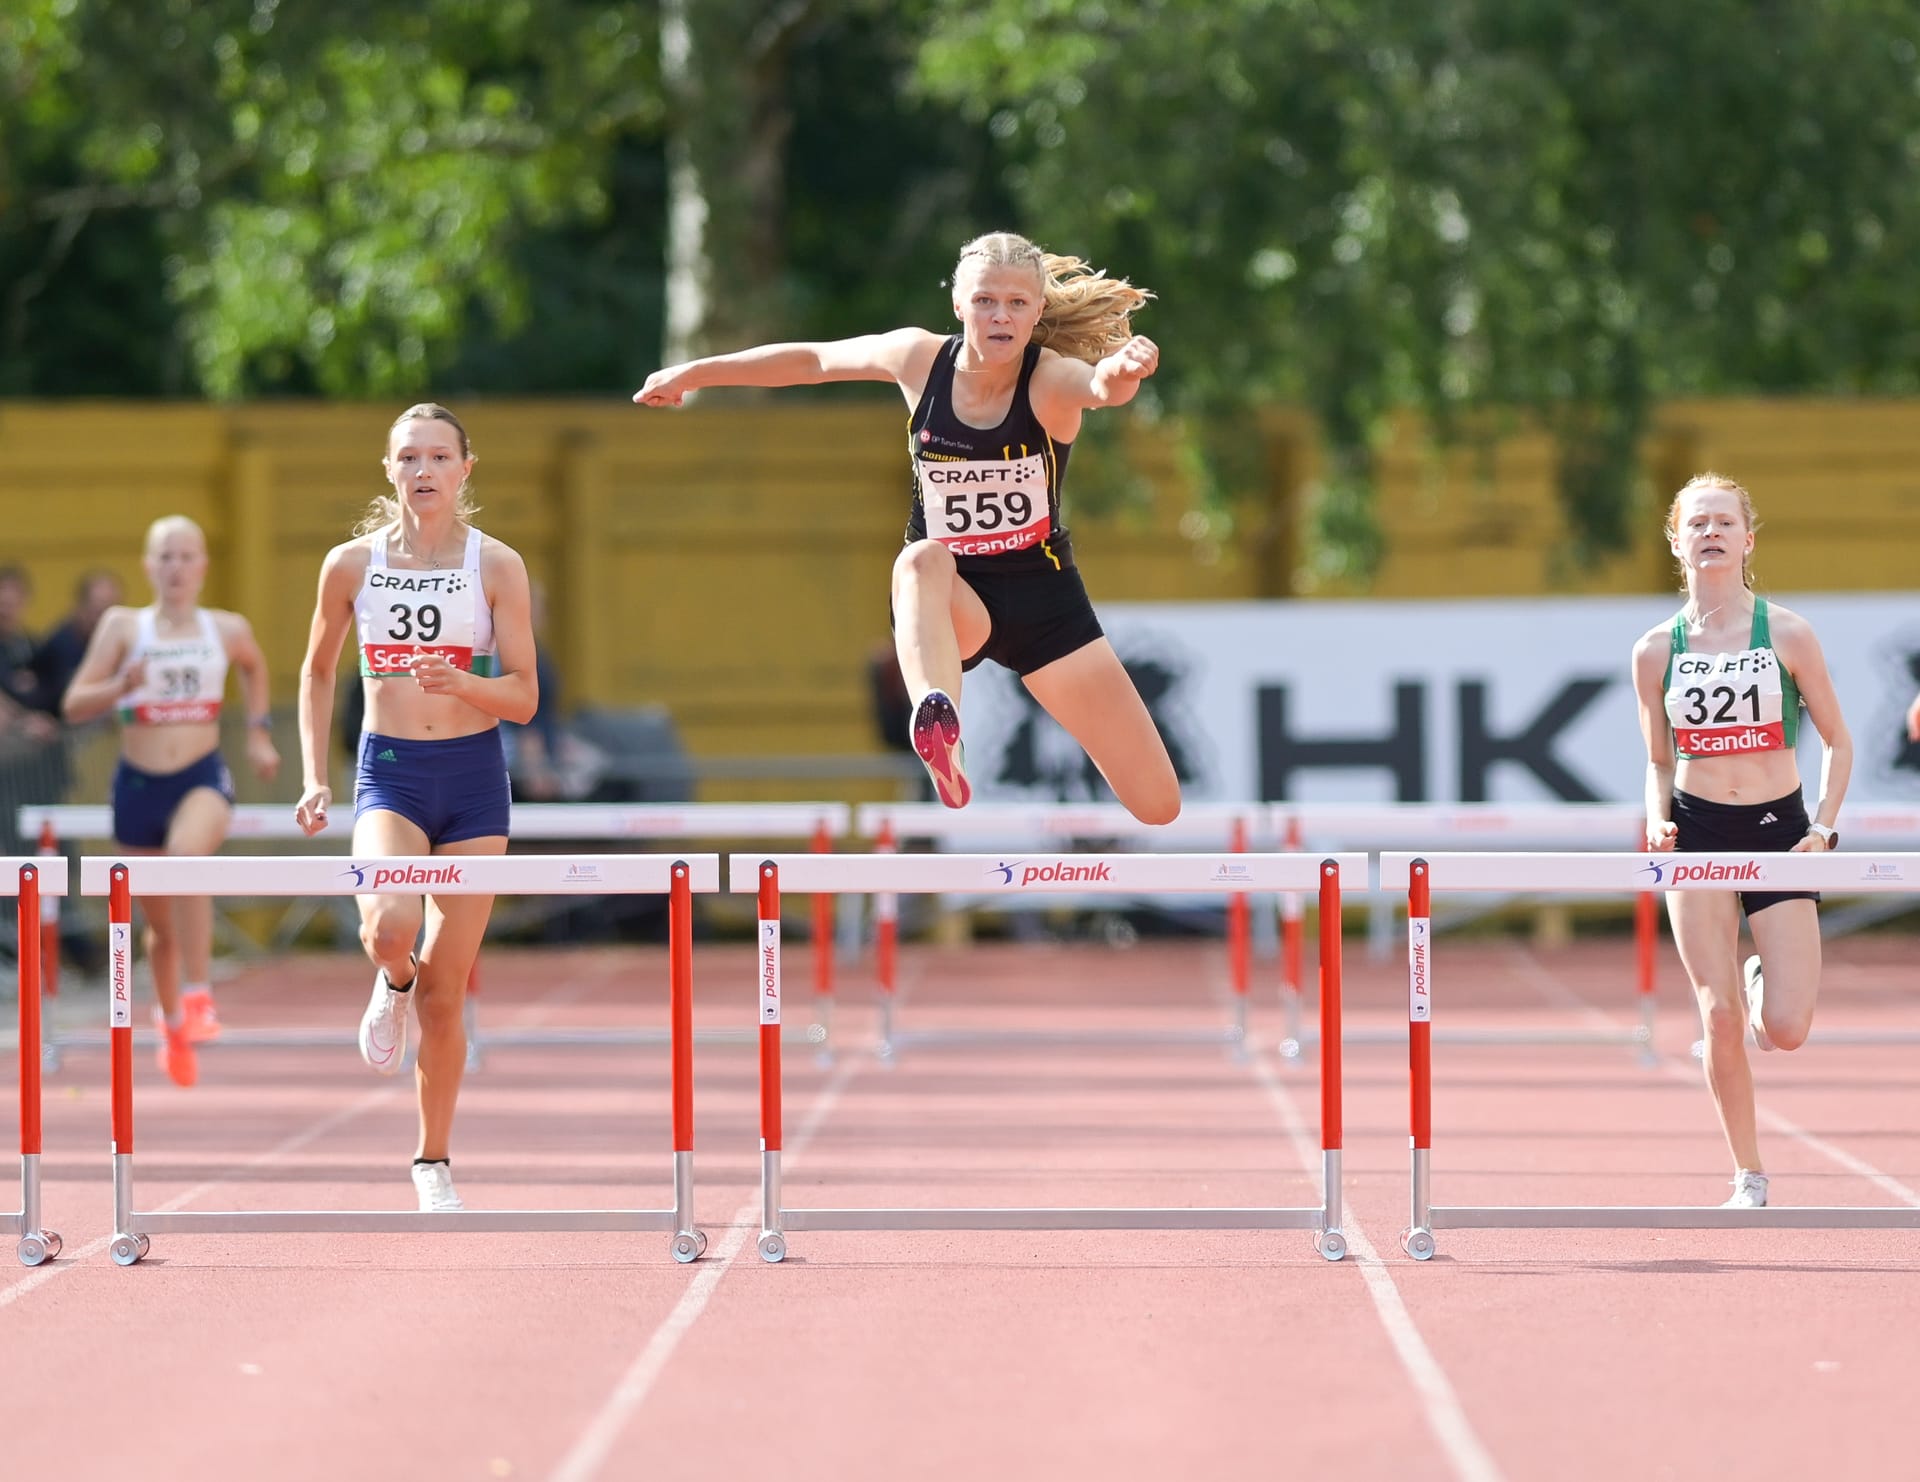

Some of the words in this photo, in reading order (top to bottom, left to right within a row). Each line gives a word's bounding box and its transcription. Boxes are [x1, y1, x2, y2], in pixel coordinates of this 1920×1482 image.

[928, 468, 1011, 484] CRAFT
[945, 491, 1032, 533] 559
[948, 531, 1036, 556] Scandic
[370, 573, 445, 592] CRAFT
[388, 603, 442, 642] 39
[373, 649, 457, 669] Scac
[1684, 684, 1761, 725] 321
[1255, 679, 1615, 802] HK
[1689, 729, 1769, 751] Scandic
[373, 864, 463, 889] polanik
[1021, 861, 1112, 887] polanik
[1671, 860, 1761, 886] polanik
[113, 948, 127, 1001] polanik
[763, 945, 777, 998] polanik
[1413, 943, 1427, 996] polanik
